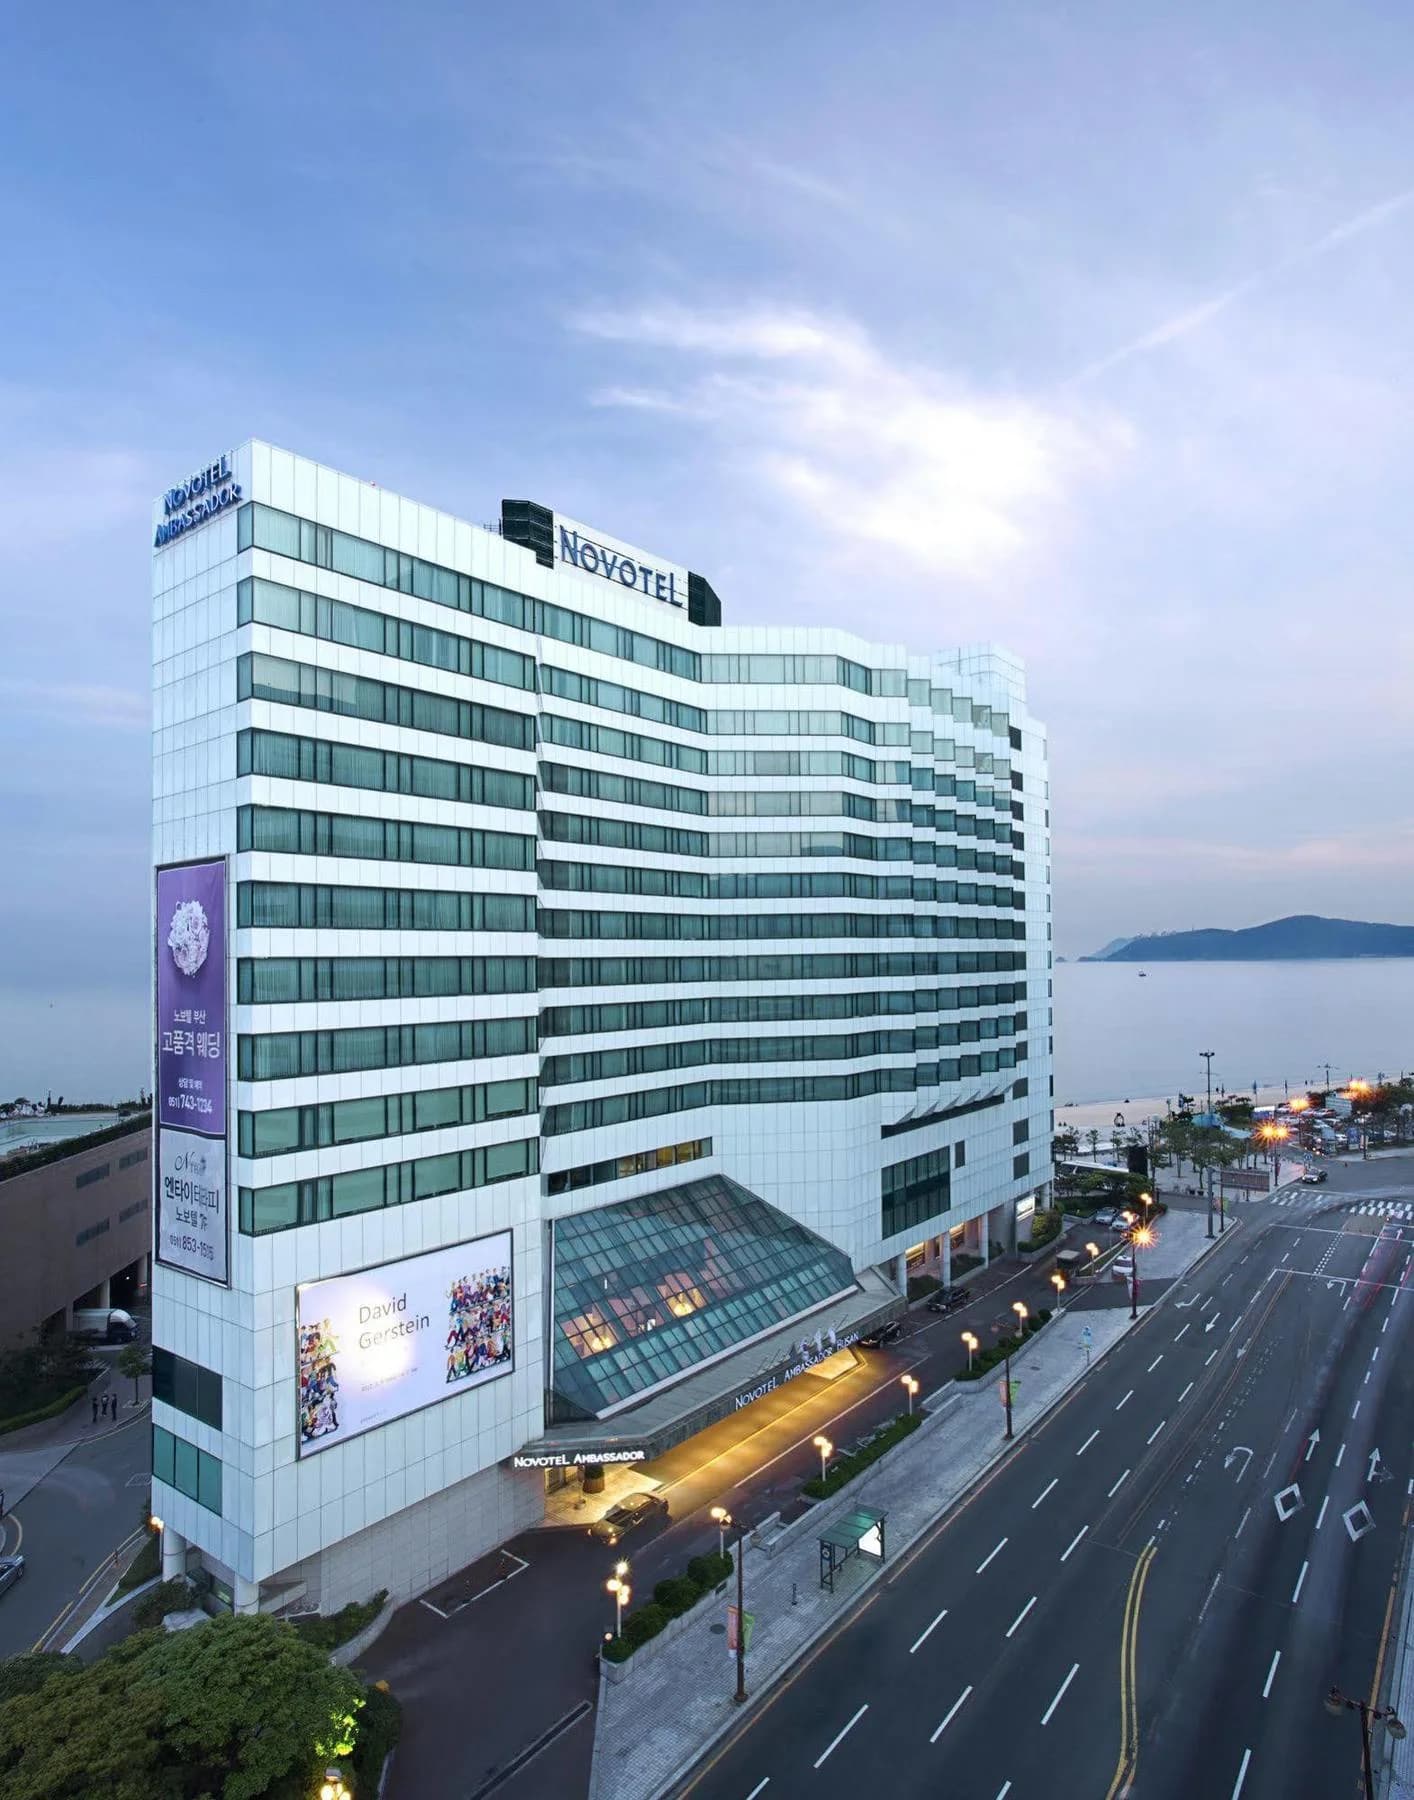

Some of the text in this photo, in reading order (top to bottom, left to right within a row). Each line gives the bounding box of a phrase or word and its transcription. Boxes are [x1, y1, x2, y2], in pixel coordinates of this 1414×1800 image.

[164, 455, 232, 516] NOVOTEL
[154, 482, 243, 548] AMBASSADOR
[560, 525, 683, 607] NOVOTEL
[162, 1030, 220, 1058] 고품격 웨딩
[359, 1292, 407, 1324] David
[359, 1314, 430, 1350] Gerstein
[735, 1331, 860, 1411] NOVOTEL AMBASSADOR BUSAN
[514, 1451, 645, 1468] NOVOTEL AMBASSADOR
